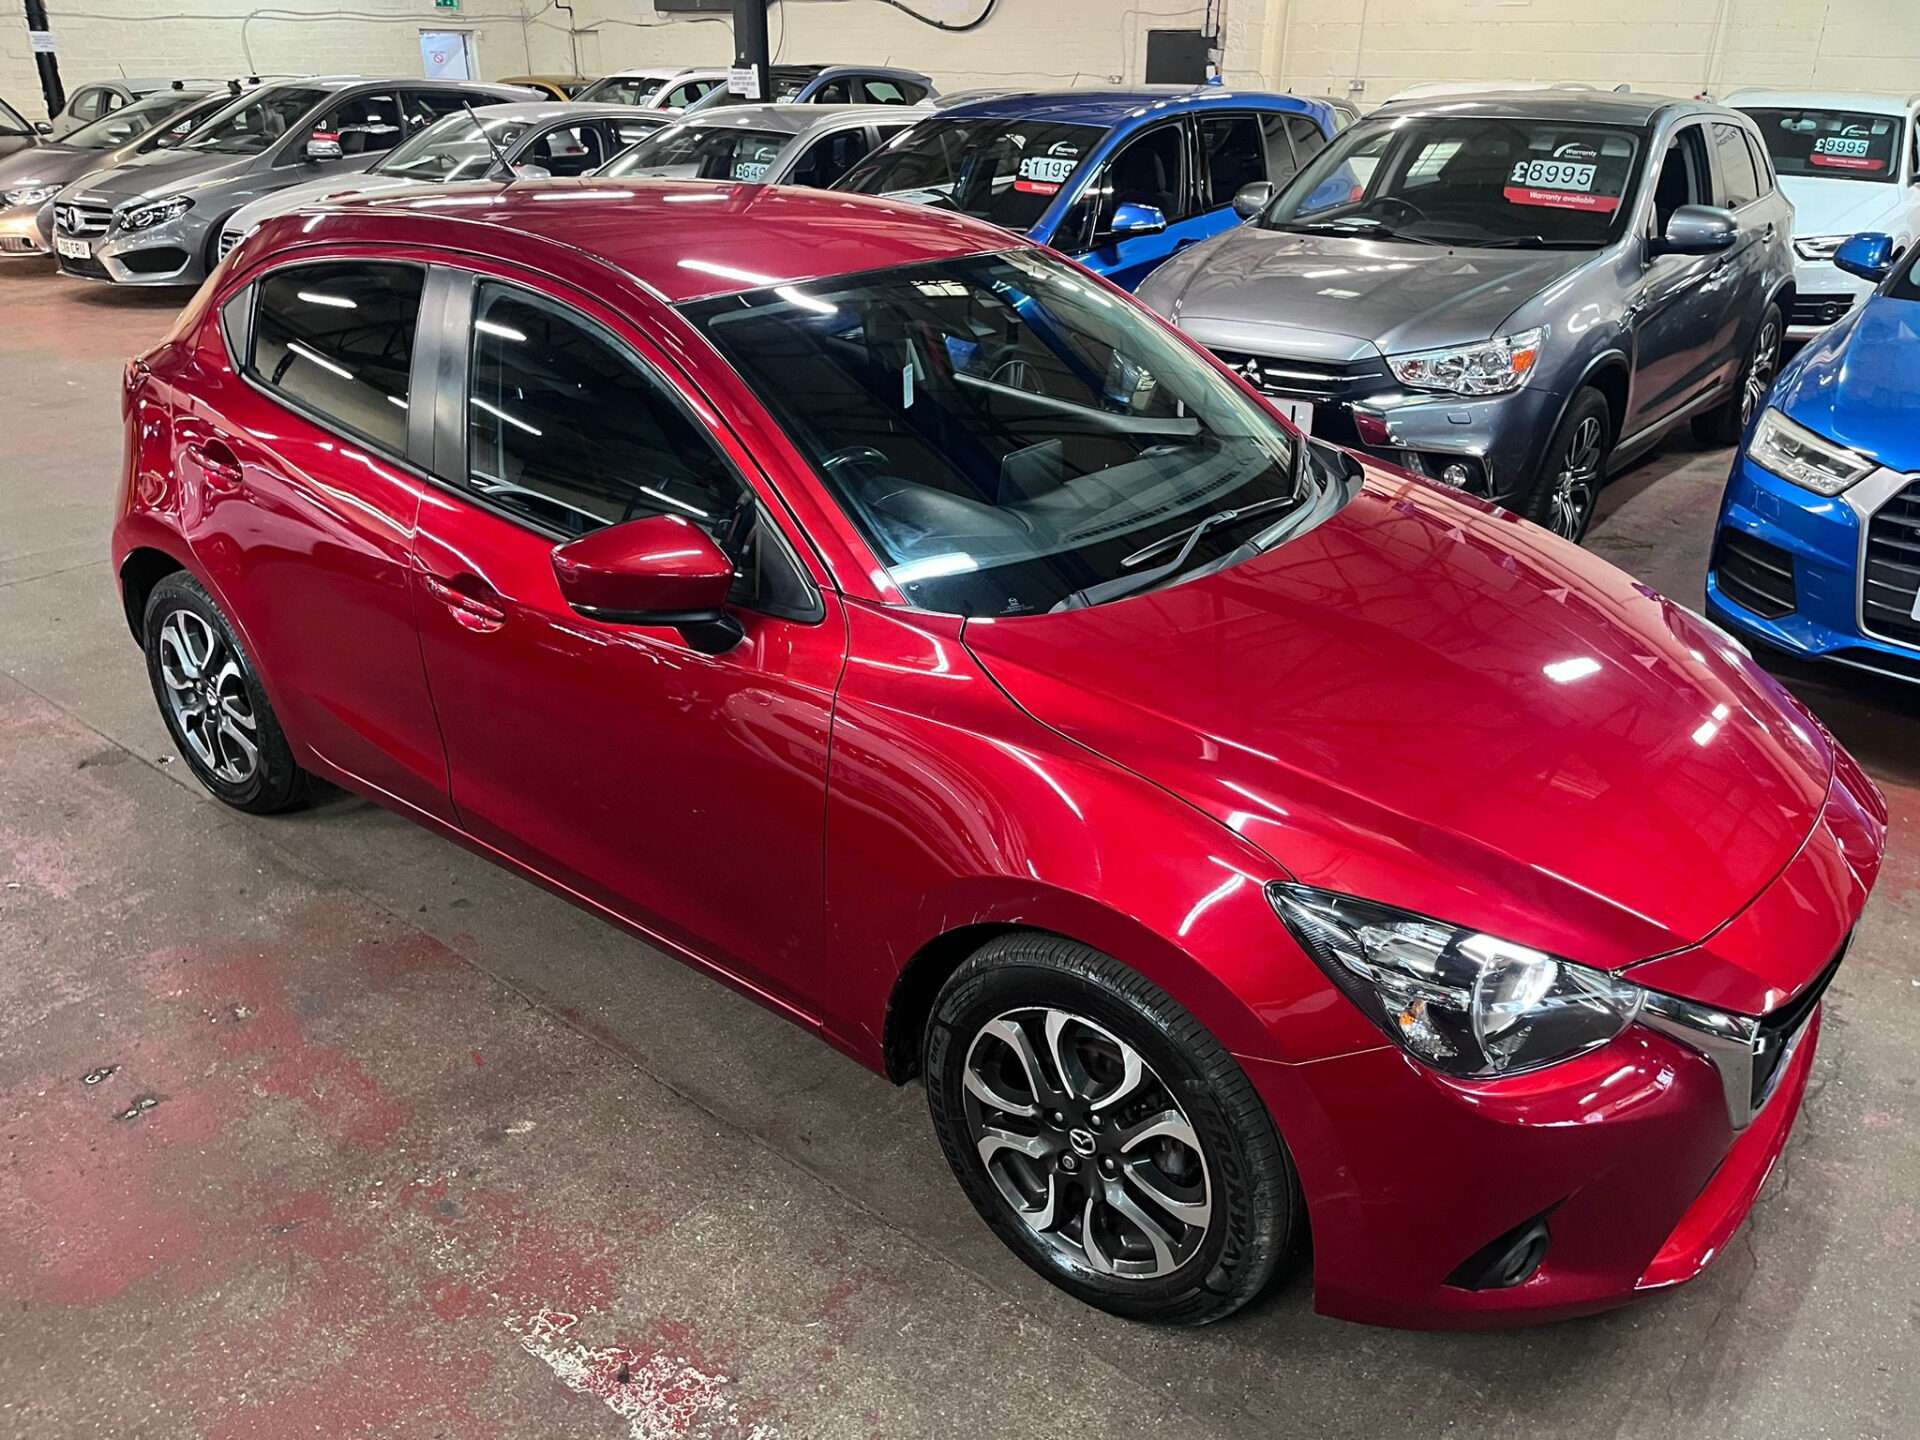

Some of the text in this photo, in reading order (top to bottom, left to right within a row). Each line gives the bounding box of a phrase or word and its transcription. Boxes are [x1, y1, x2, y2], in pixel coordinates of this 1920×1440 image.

[1566, 149, 1597, 158] Warranty
[1814, 138, 1867, 154] £9995
[1511, 161, 1593, 186] £8995
[1529, 191, 1562, 202] Warranty
[1203, 1108, 1248, 1279] FRONWAY
